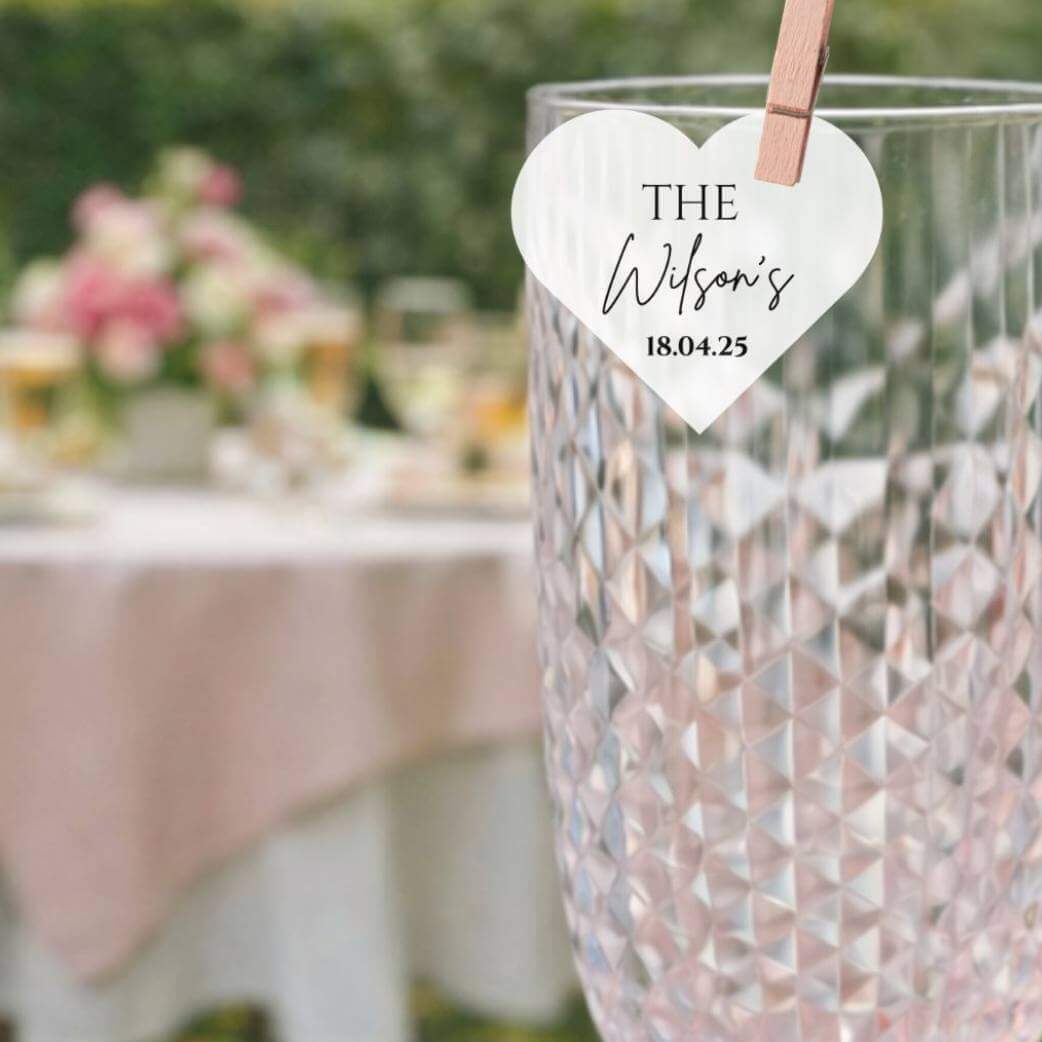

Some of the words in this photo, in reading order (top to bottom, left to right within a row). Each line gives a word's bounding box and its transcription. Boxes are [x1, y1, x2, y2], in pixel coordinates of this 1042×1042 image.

[641, 183, 739, 221] THE
[602, 232, 795, 316] Wilson's
[646, 335, 748, 358] 18.04.25
